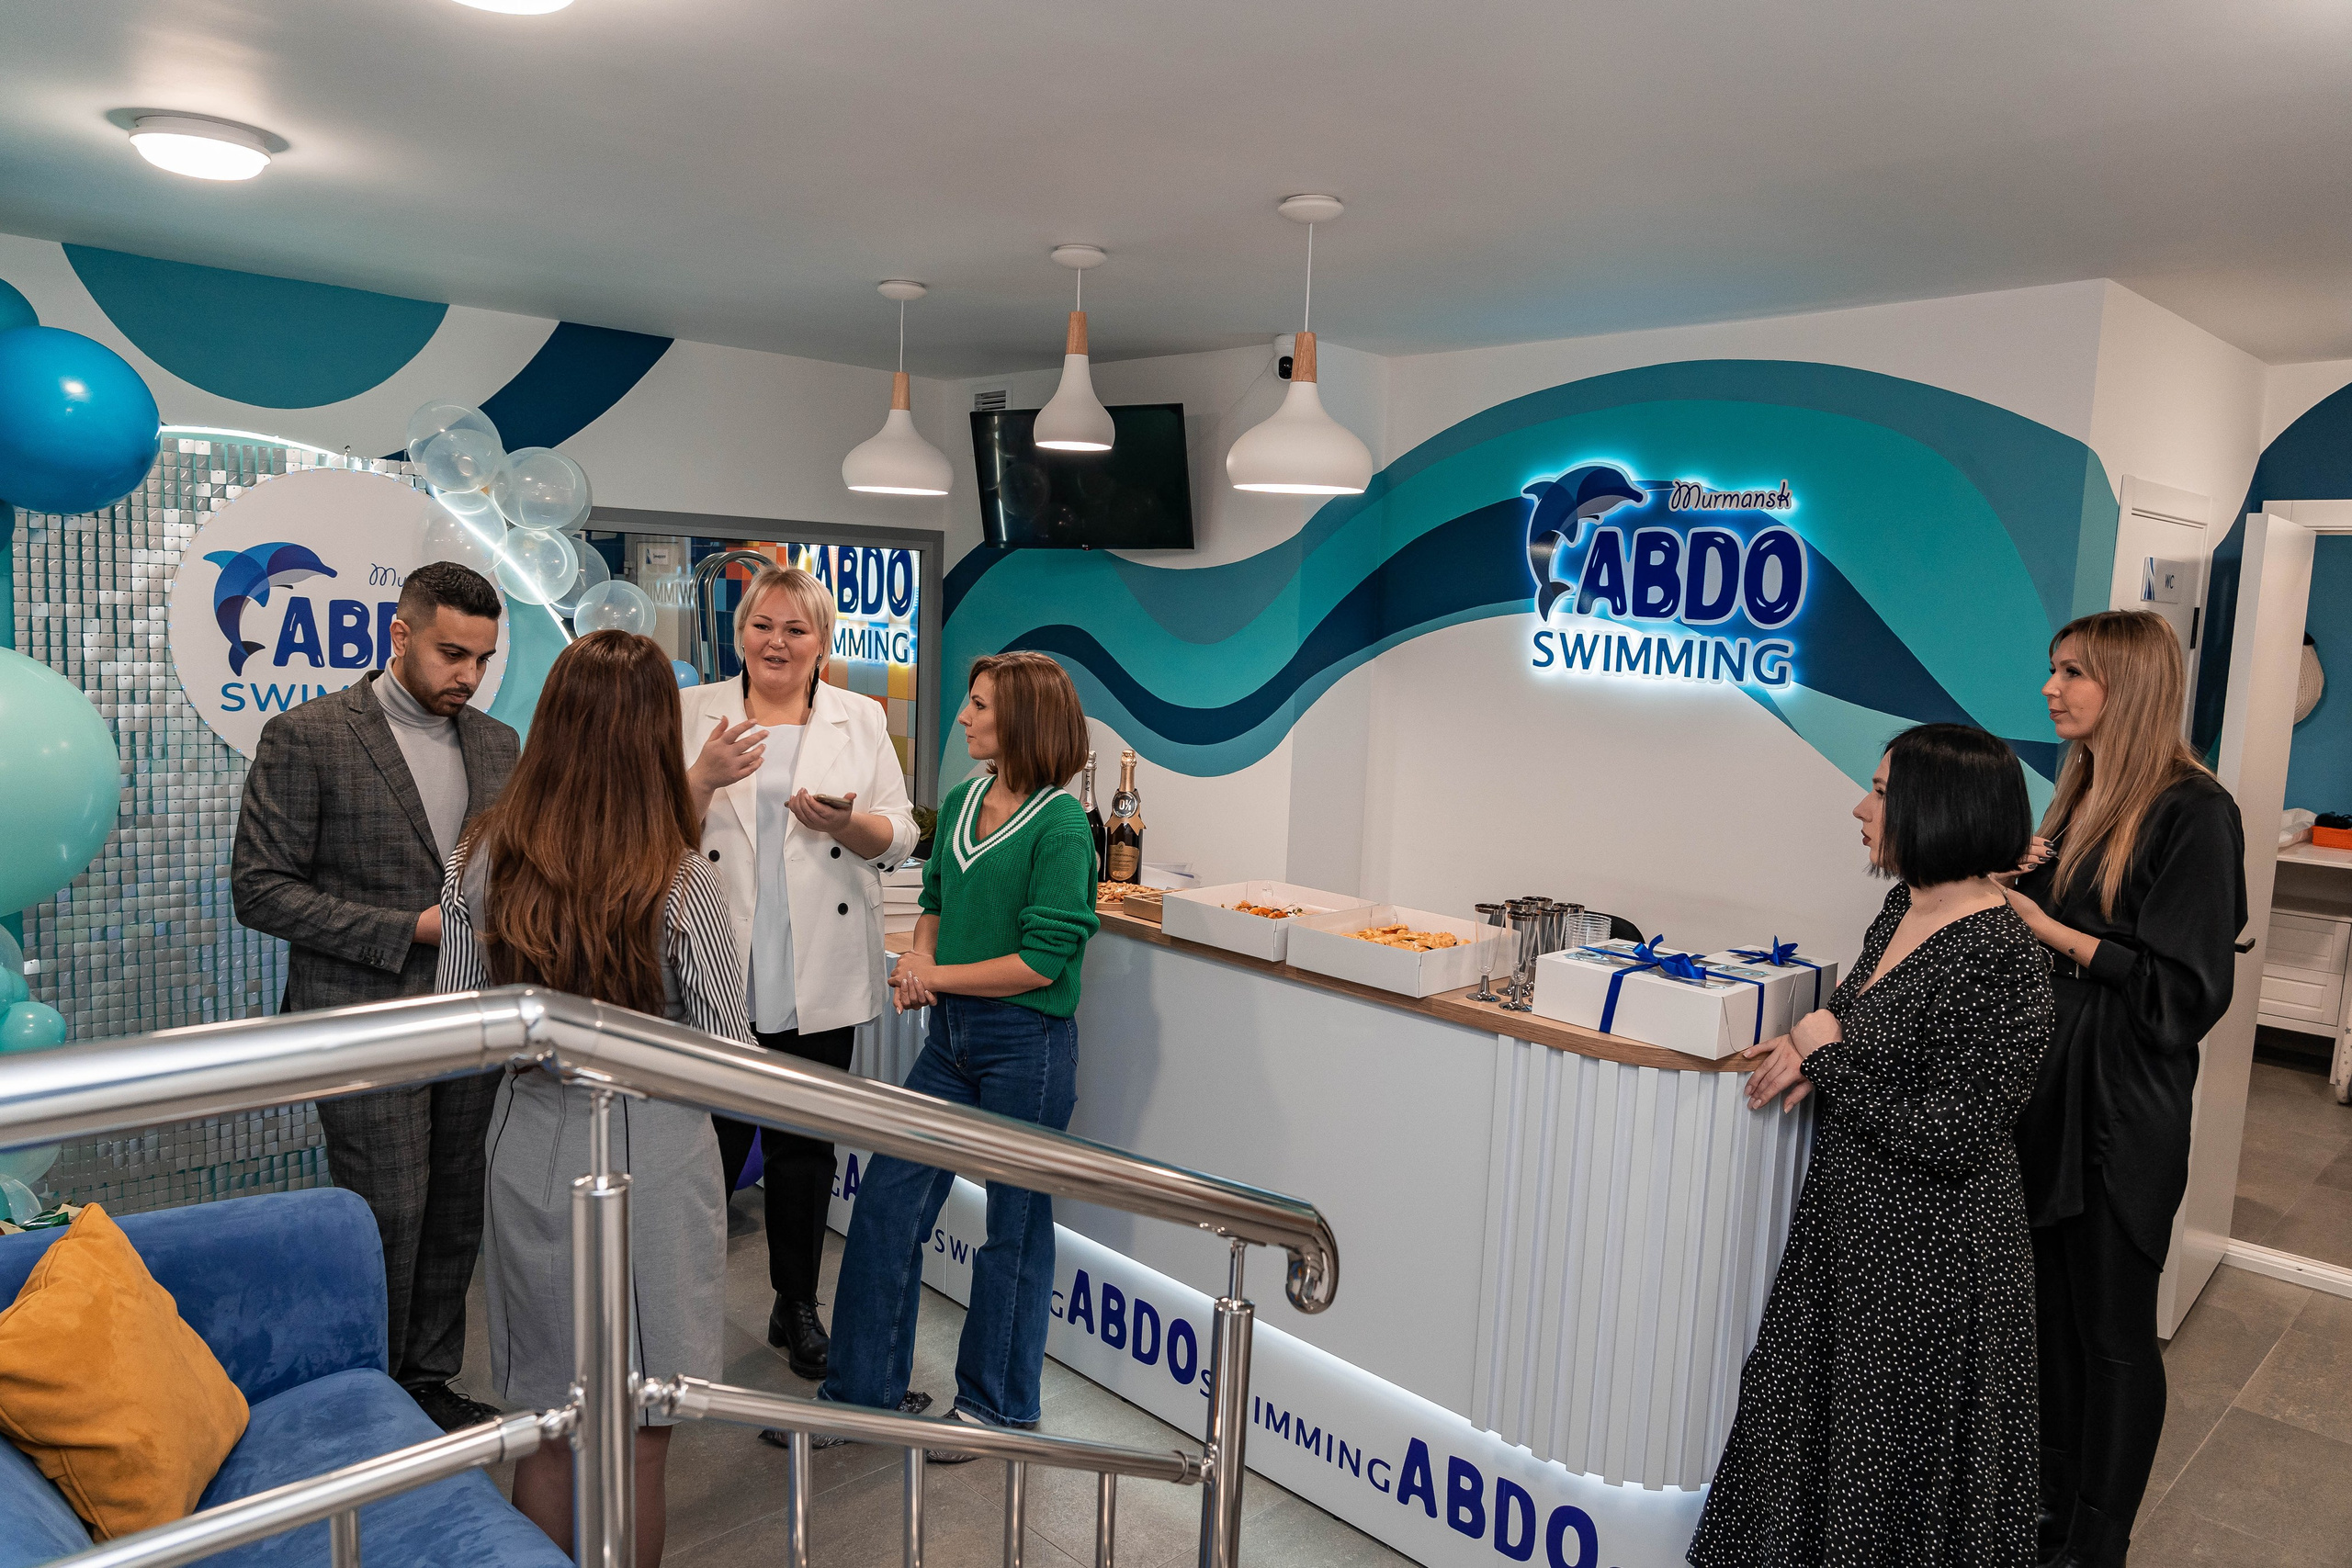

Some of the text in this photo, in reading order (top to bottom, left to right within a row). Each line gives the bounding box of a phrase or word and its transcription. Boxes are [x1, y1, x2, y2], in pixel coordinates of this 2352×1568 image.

[1670, 479, 1792, 510] Murmansk
[1576, 530, 1803, 626] ABDO
[2165, 574, 2175, 589] WC
[831, 628, 908, 663] MMING
[1532, 630, 1789, 685] SWIMMING
[1118, 799, 1132, 811] 0%
[1068, 1269, 1197, 1385] ABDO
[1200, 1369, 1391, 1494] SIMMING
[1396, 1437, 1599, 1568] ABDO
